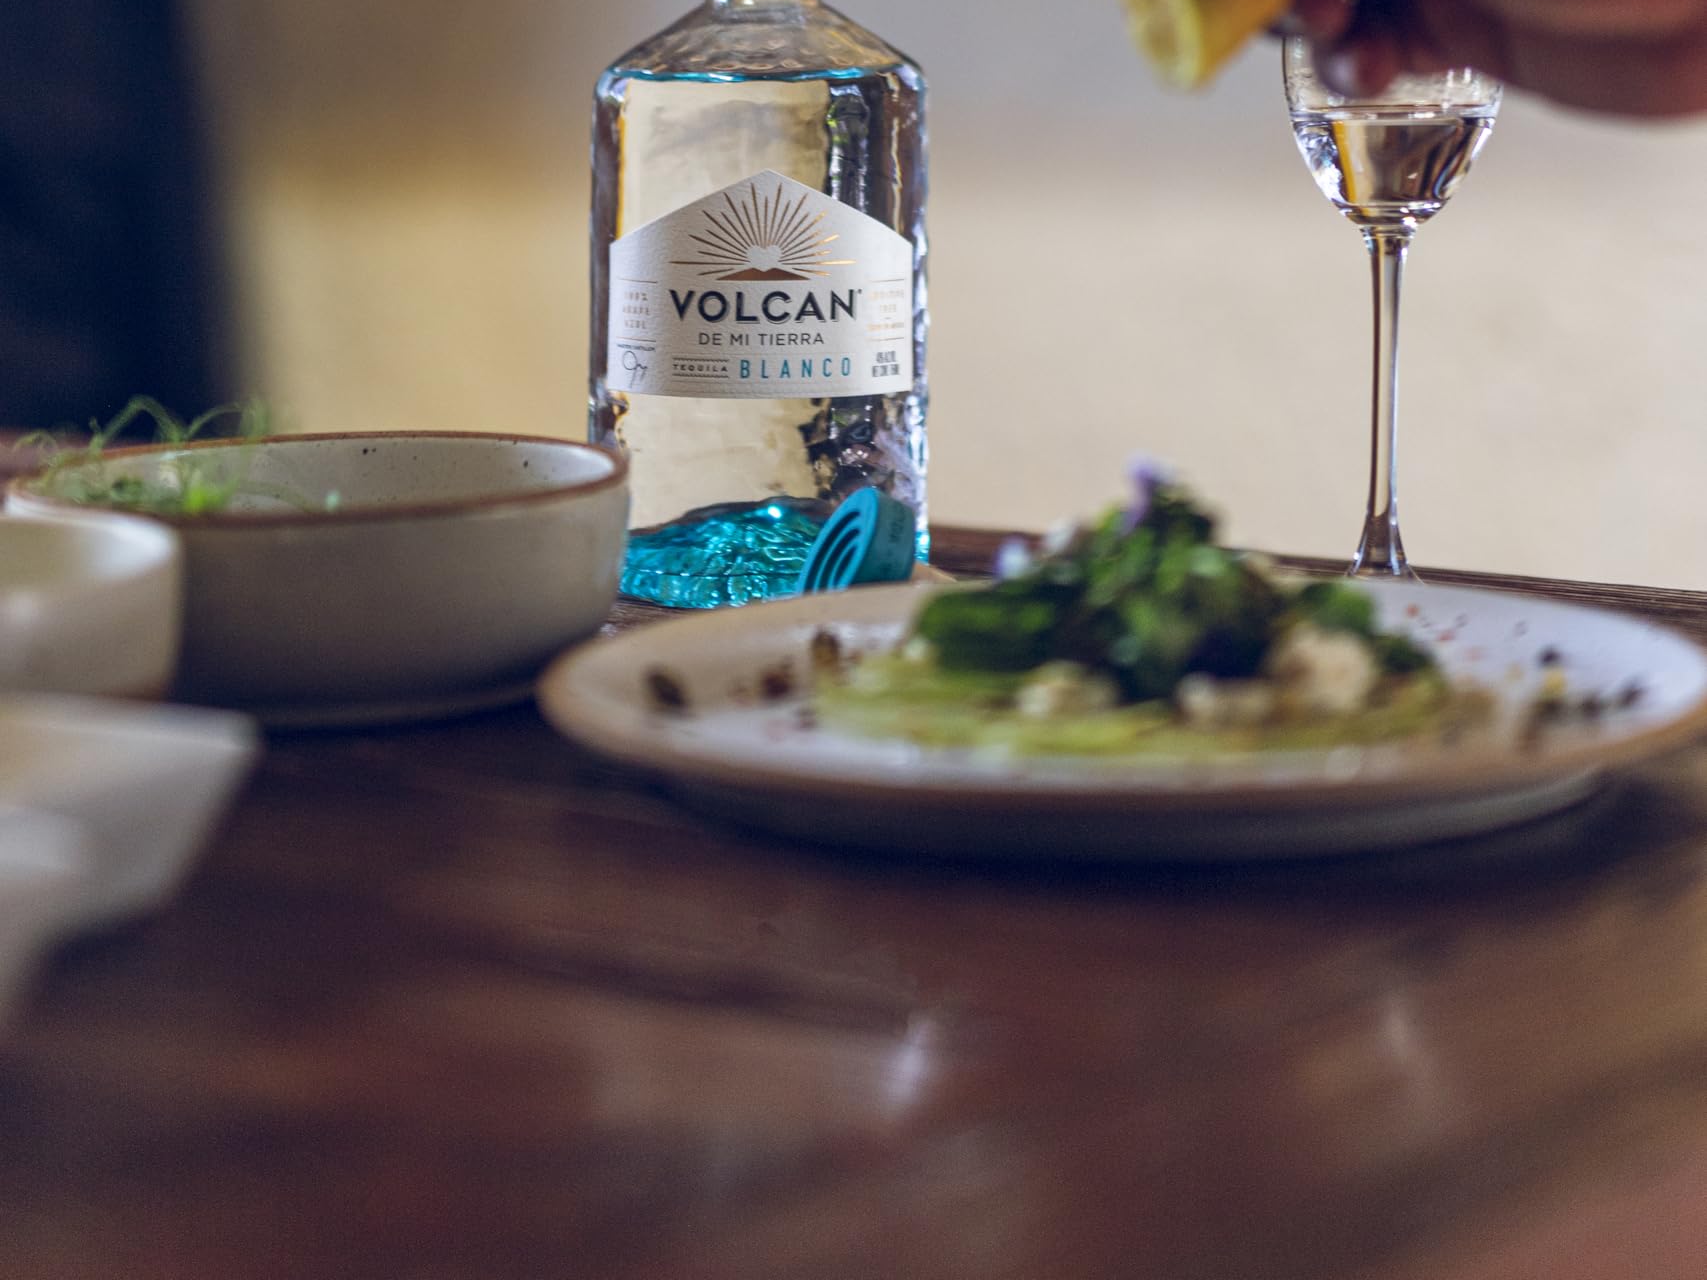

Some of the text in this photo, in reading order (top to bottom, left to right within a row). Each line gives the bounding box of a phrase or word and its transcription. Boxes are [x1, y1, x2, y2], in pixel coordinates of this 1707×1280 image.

[669, 289, 858, 324] VOLCAN
[698, 331, 825, 346] DE MI TIERRA
[672, 356, 851, 379] TEQUILA BLANCO
